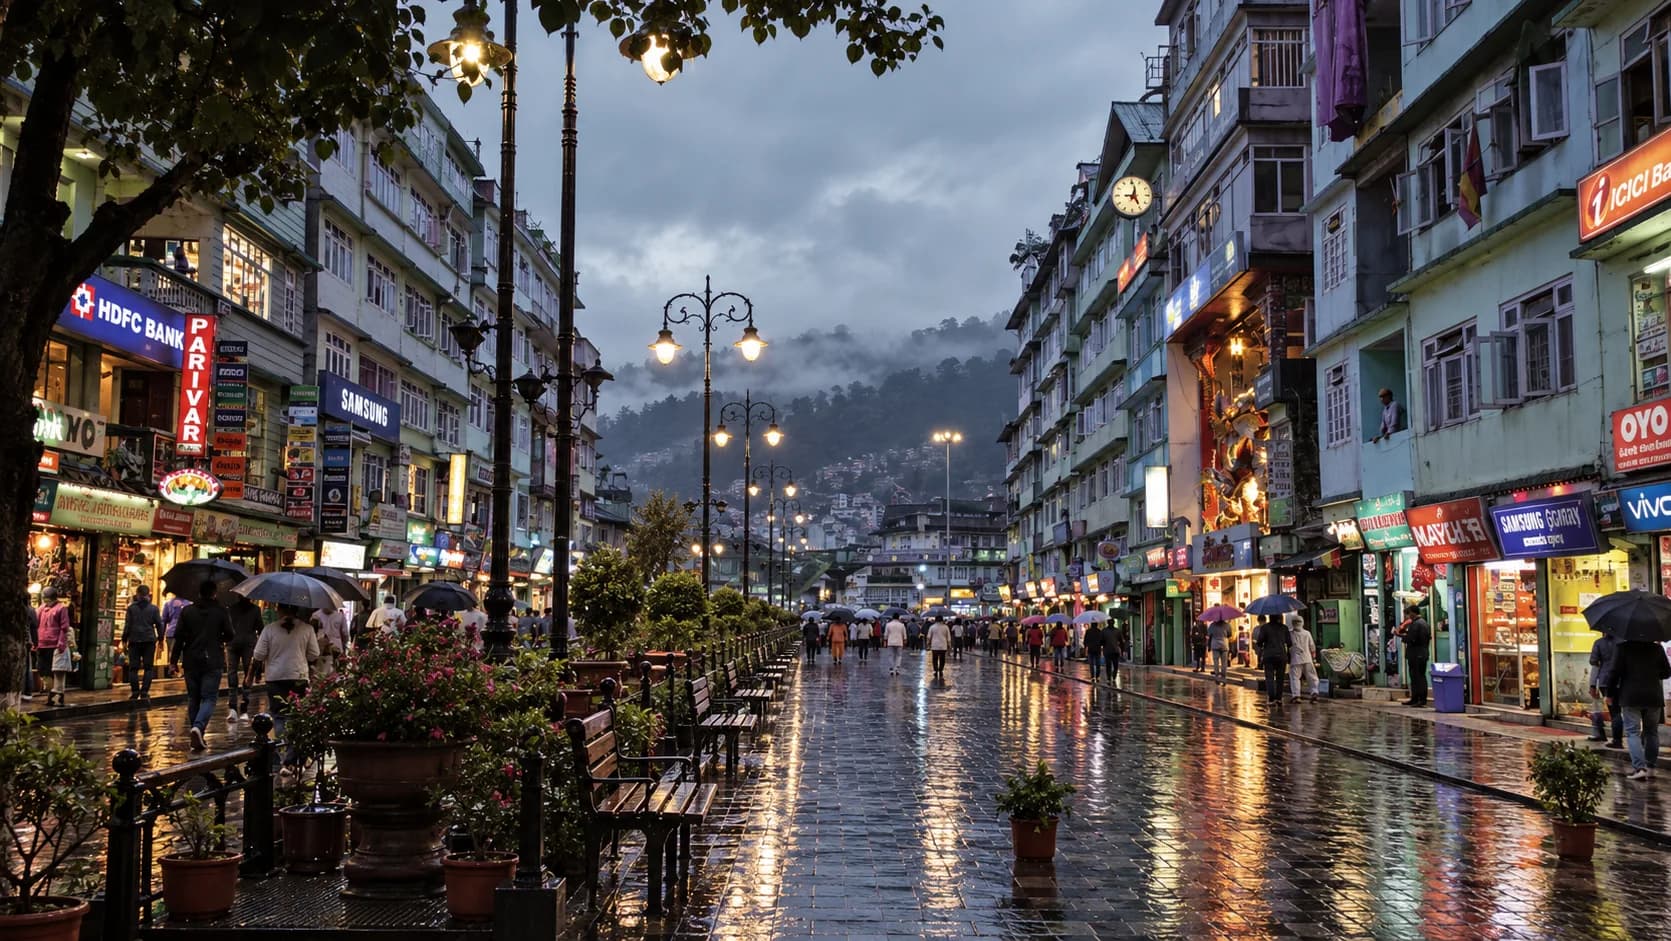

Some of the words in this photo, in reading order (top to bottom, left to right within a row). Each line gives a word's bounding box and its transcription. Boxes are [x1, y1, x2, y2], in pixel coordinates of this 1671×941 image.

[1610, 169, 1649, 211] ICICI
[98, 298, 142, 334] HDFC
[145, 317, 184, 350] BANK
[182, 318, 208, 441] PARIVAR
[341, 388, 388, 427] SAMSUNG
[1621, 405, 1668, 442] OYO
[1500, 511, 1545, 534] SAMSUNG
